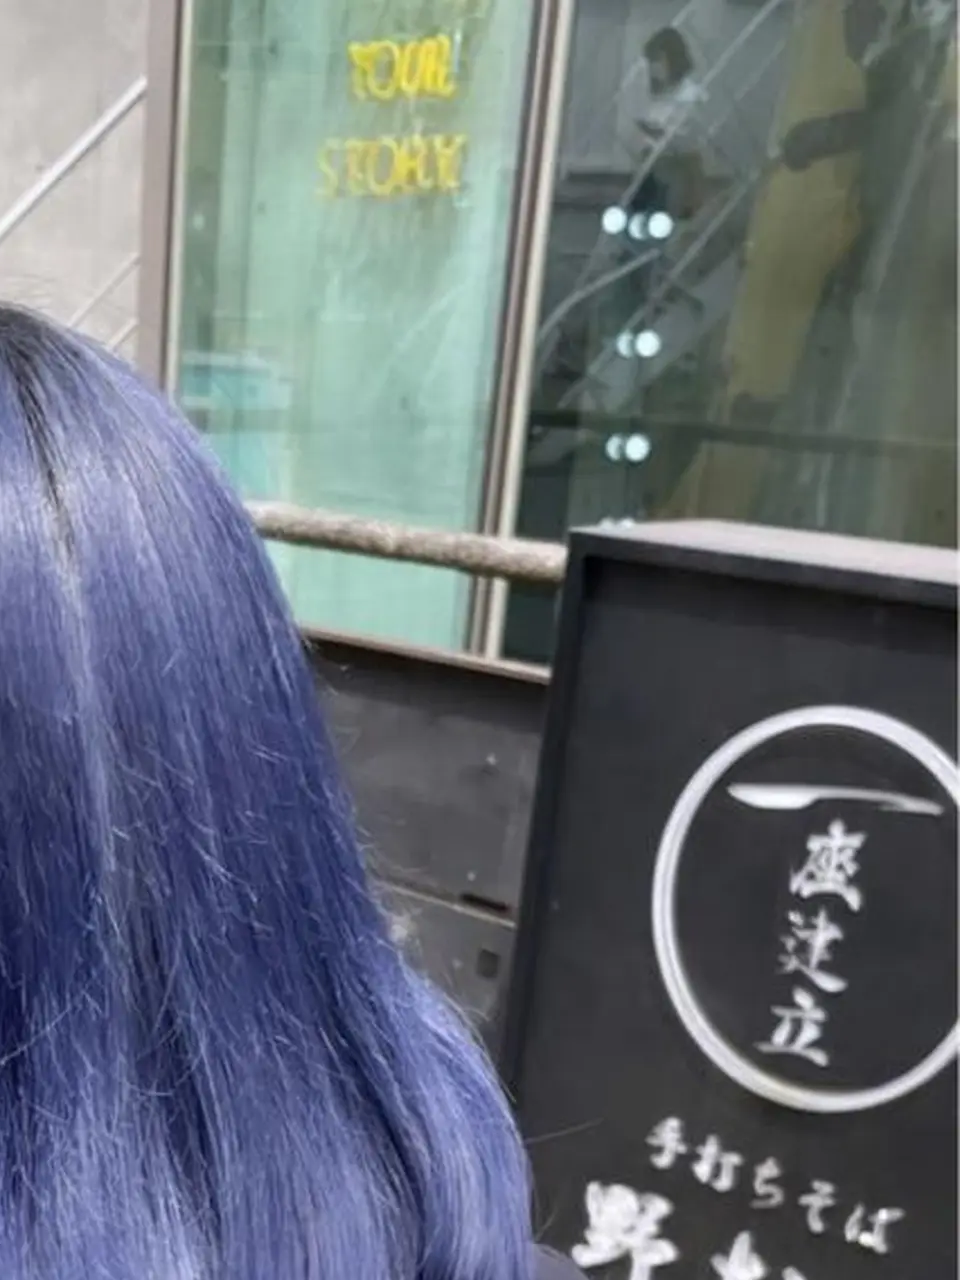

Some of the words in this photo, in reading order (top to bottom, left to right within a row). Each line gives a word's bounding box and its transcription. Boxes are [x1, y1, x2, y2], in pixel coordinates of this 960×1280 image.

[645, 1114, 906, 1254] 手打ちそば
